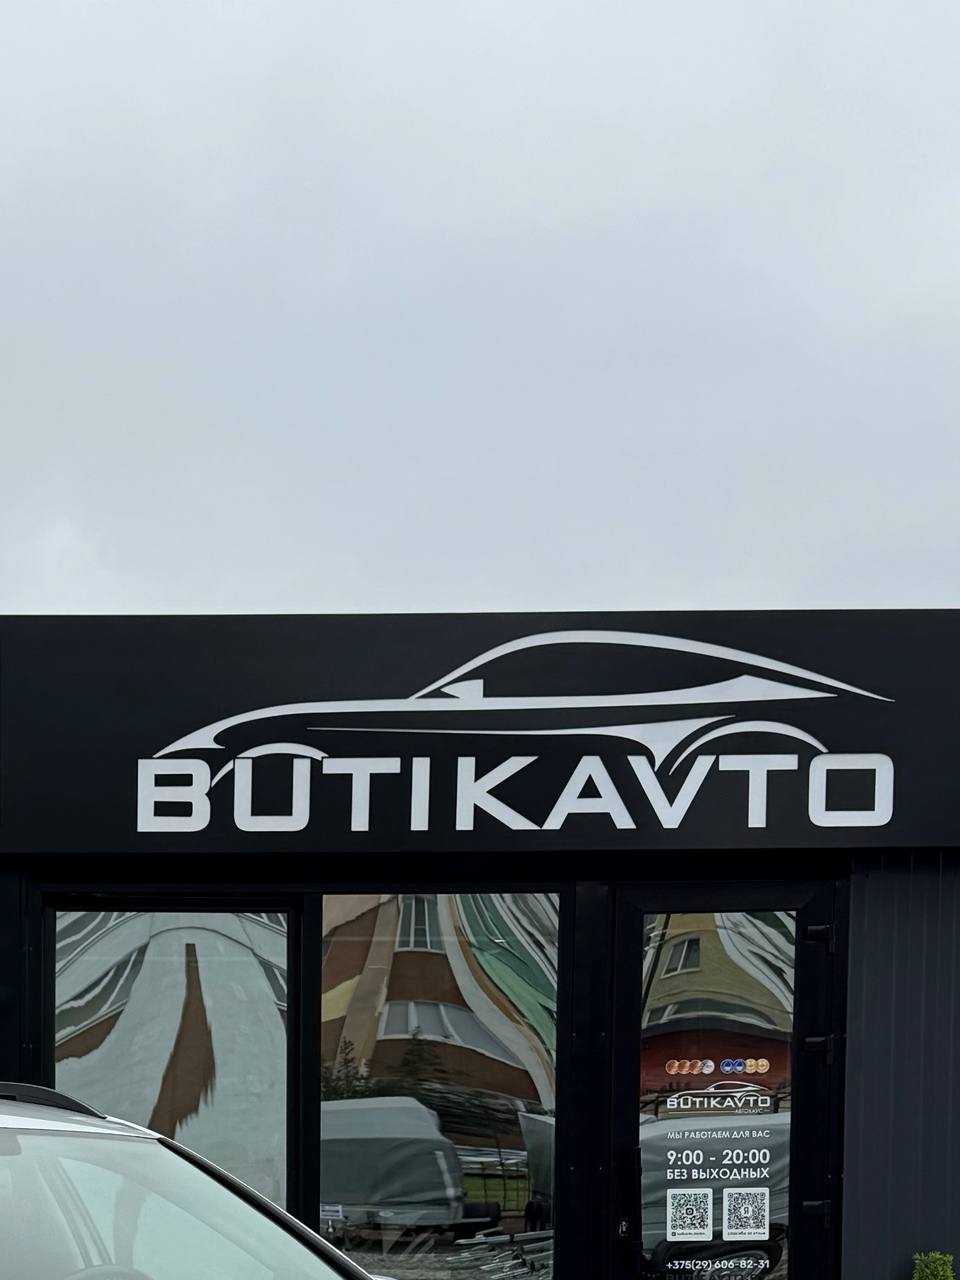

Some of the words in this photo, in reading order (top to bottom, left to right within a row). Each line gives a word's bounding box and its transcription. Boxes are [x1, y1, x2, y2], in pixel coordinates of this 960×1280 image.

[137, 752, 895, 833] BUTIKAVTO
[667, 1096, 771, 1109] BUTIKAVTO
[684, 1131, 730, 1139] РАБОТАЕМ
[732, 1130, 750, 1138] ДЛЯ
[752, 1130, 770, 1138] ВАС
[667, 1149, 704, 1165] 9:00
[722, 1149, 771, 1164] 20:00
[666, 1168, 688, 1180] БЕЗ
[691, 1167, 770, 1180] ВЫХОДНЫХ
[665, 1259, 713, 1271] +375(29)
[714, 1258, 771, 1270] 606-82-31
